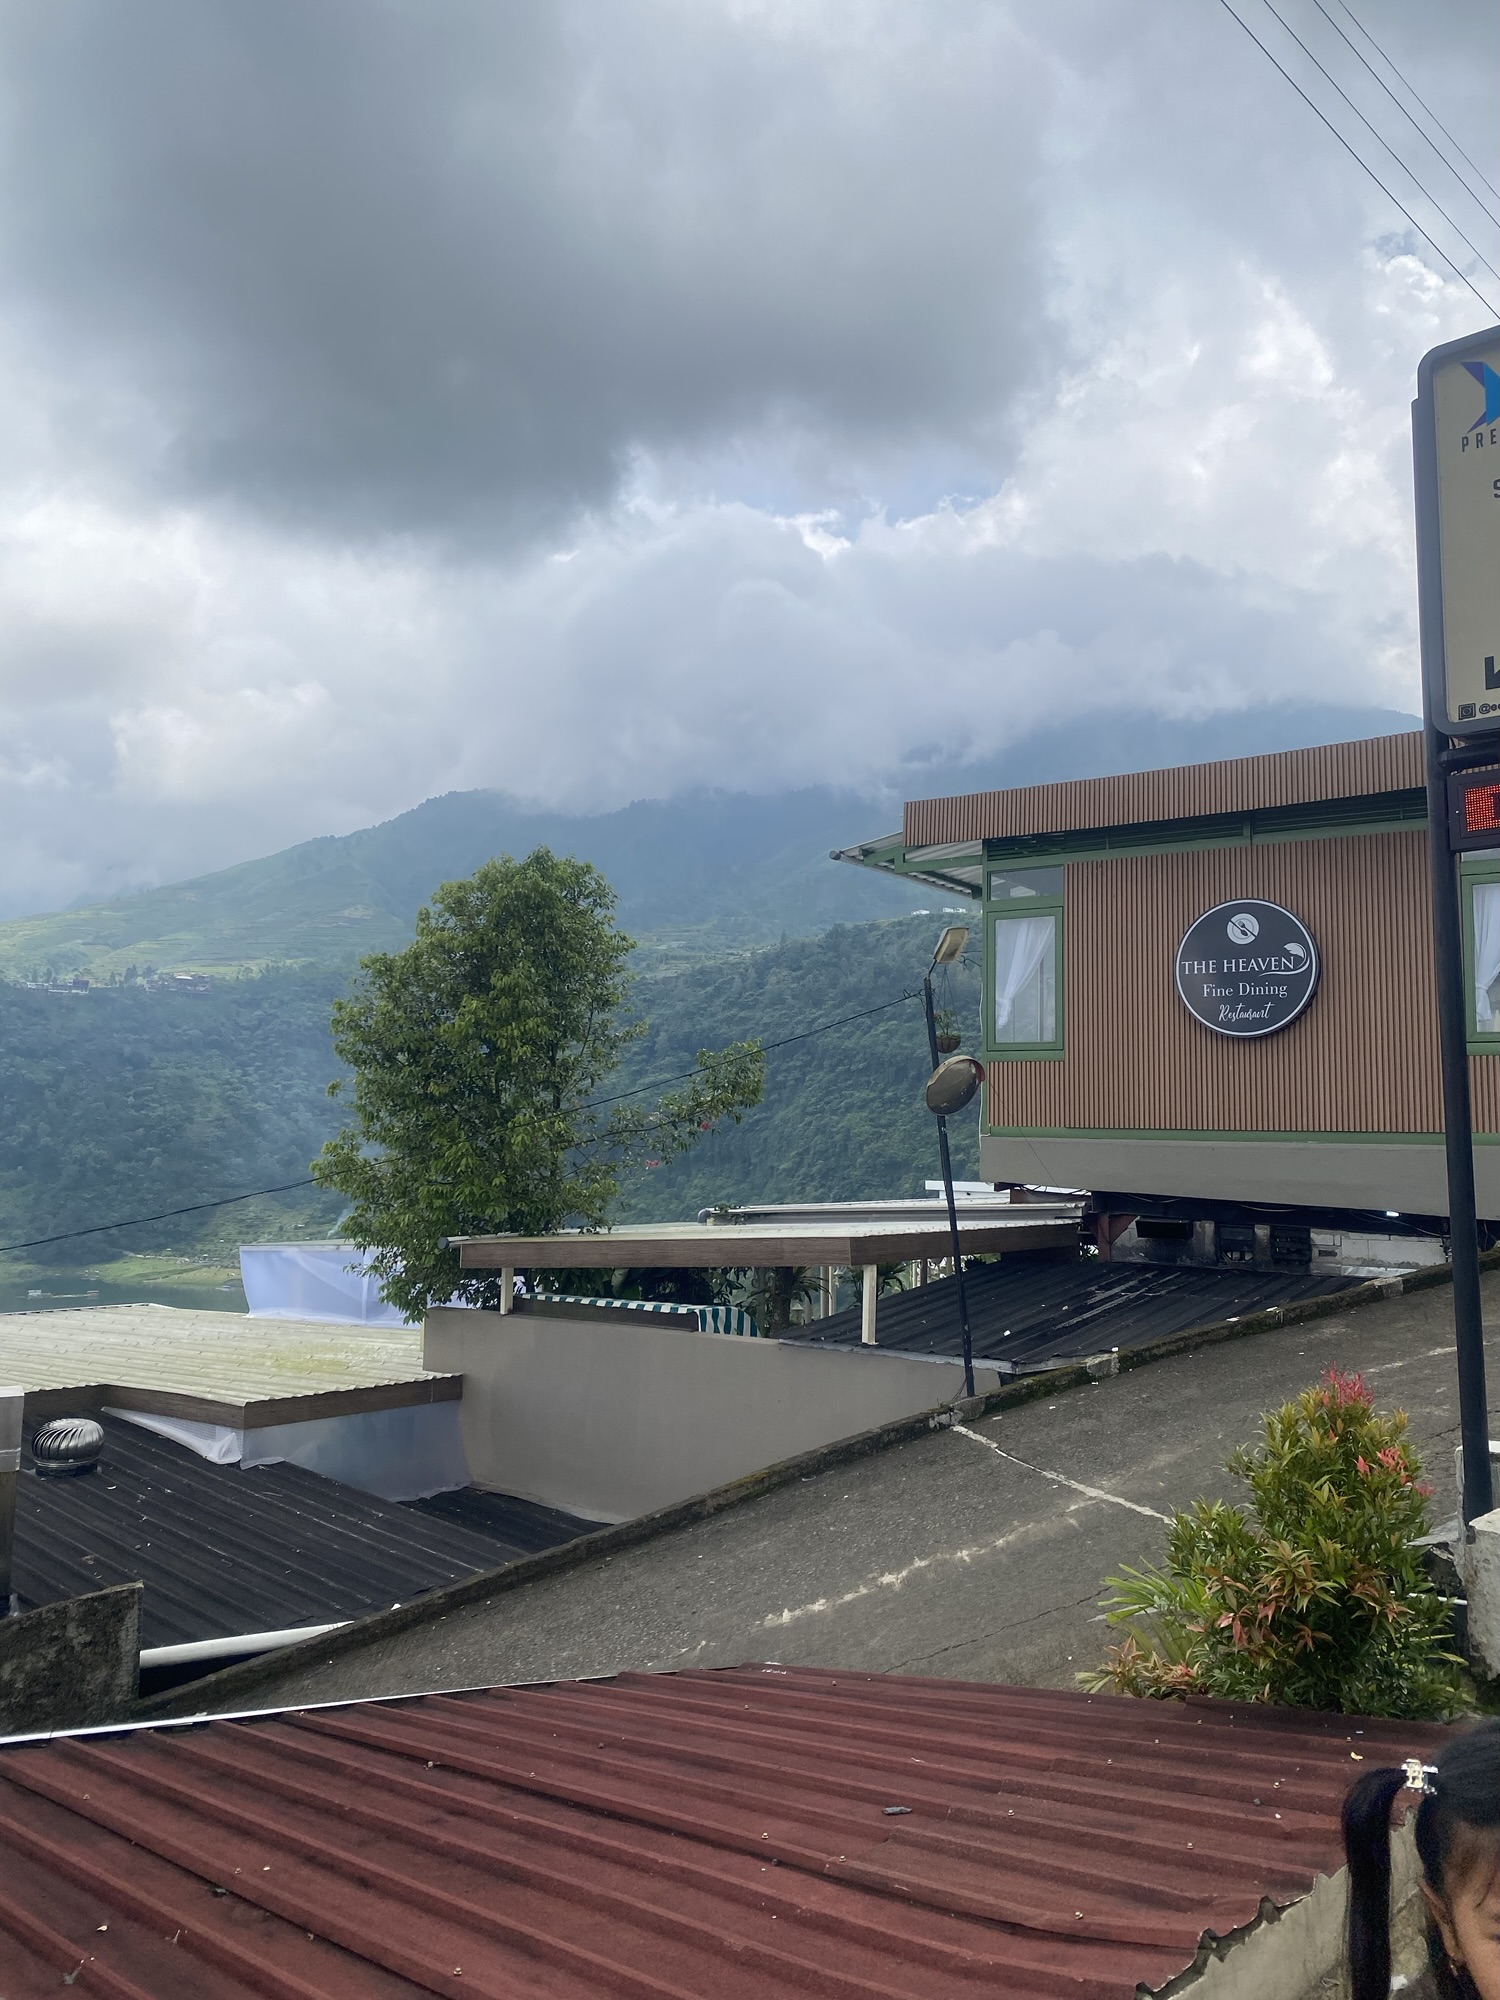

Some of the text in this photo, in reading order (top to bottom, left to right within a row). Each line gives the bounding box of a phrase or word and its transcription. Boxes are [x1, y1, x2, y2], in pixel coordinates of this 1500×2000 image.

[1181, 956, 1294, 975] THE HEAVEN
[1202, 981, 1288, 998] Fine Dining
[1218, 1001, 1275, 1022] Restaurant
